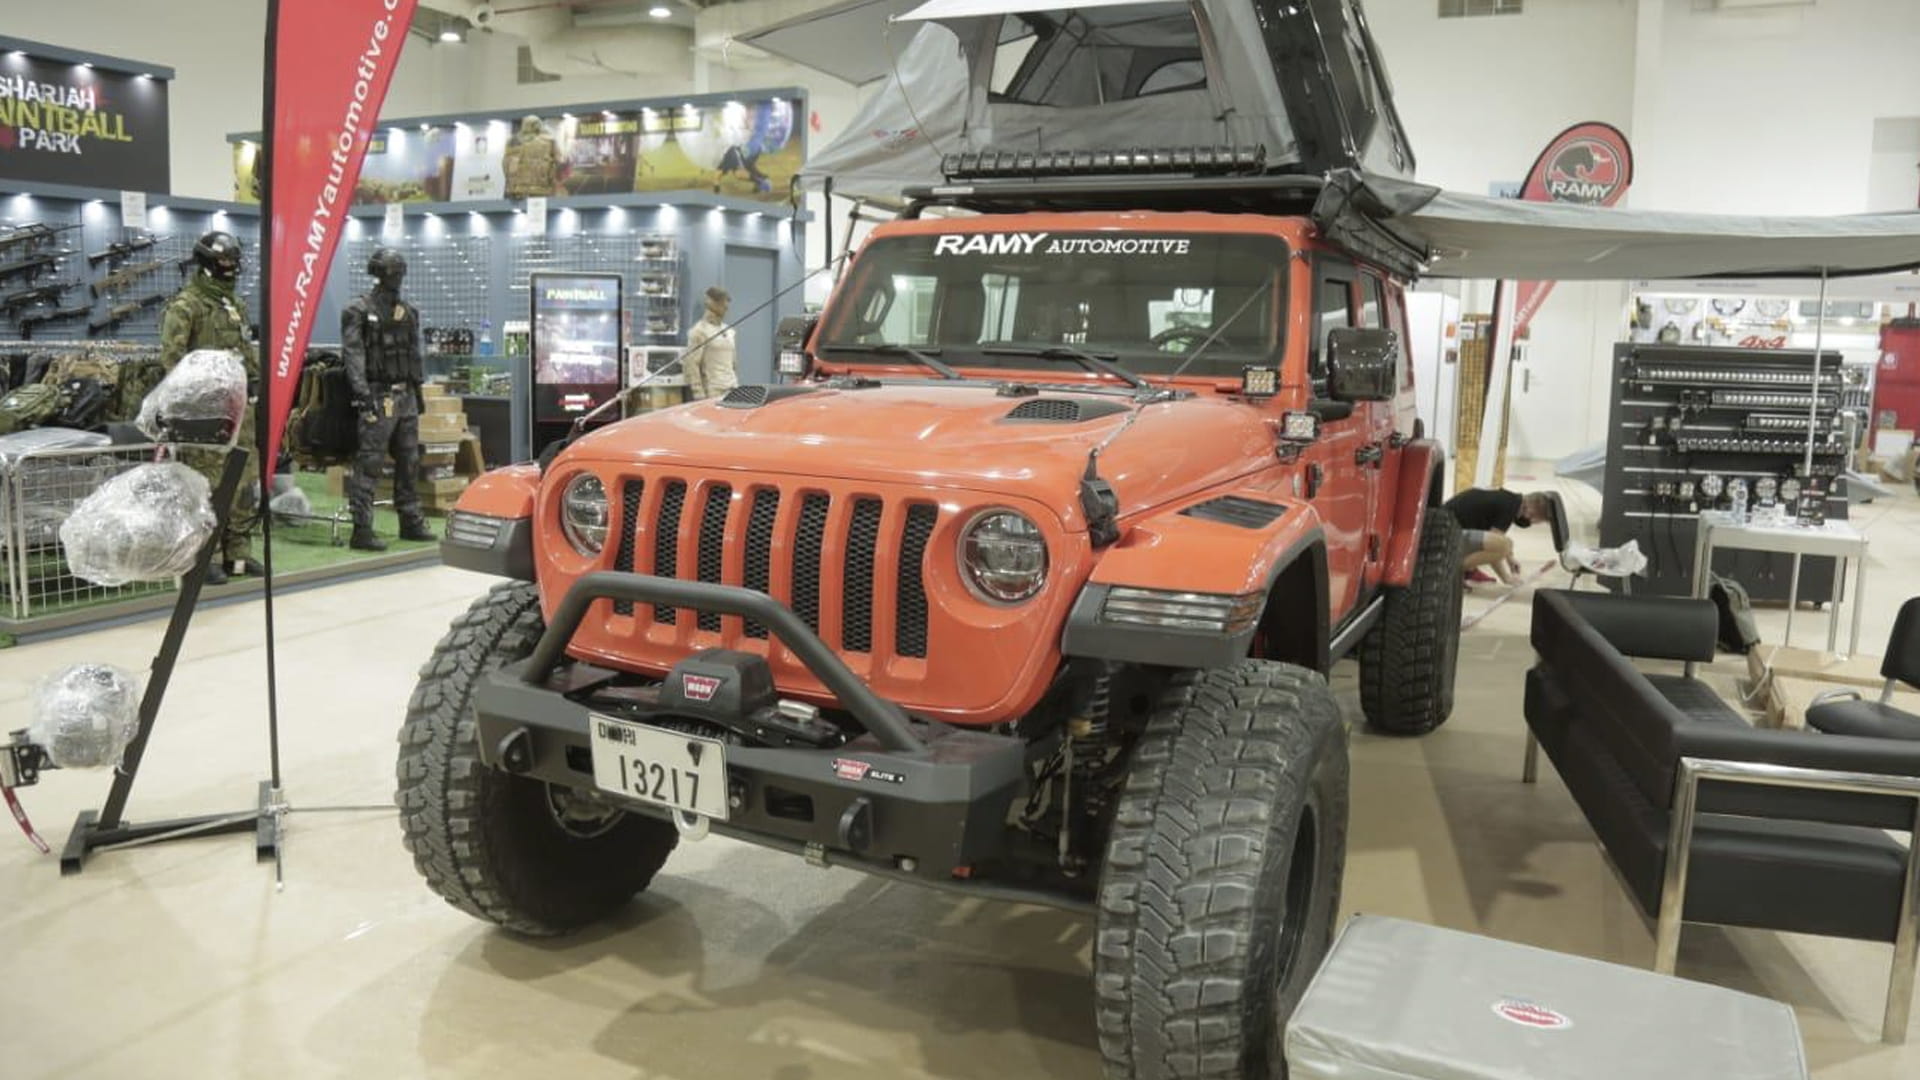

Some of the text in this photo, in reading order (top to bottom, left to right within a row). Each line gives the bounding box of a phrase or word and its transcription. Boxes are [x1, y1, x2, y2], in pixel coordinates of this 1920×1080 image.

[20, 127, 82, 154] PARK
[1551, 181, 1613, 199] RAMY
[934, 232, 1190, 256] RAMY AUTOMOTIVE
[619, 754, 700, 808] 13217
